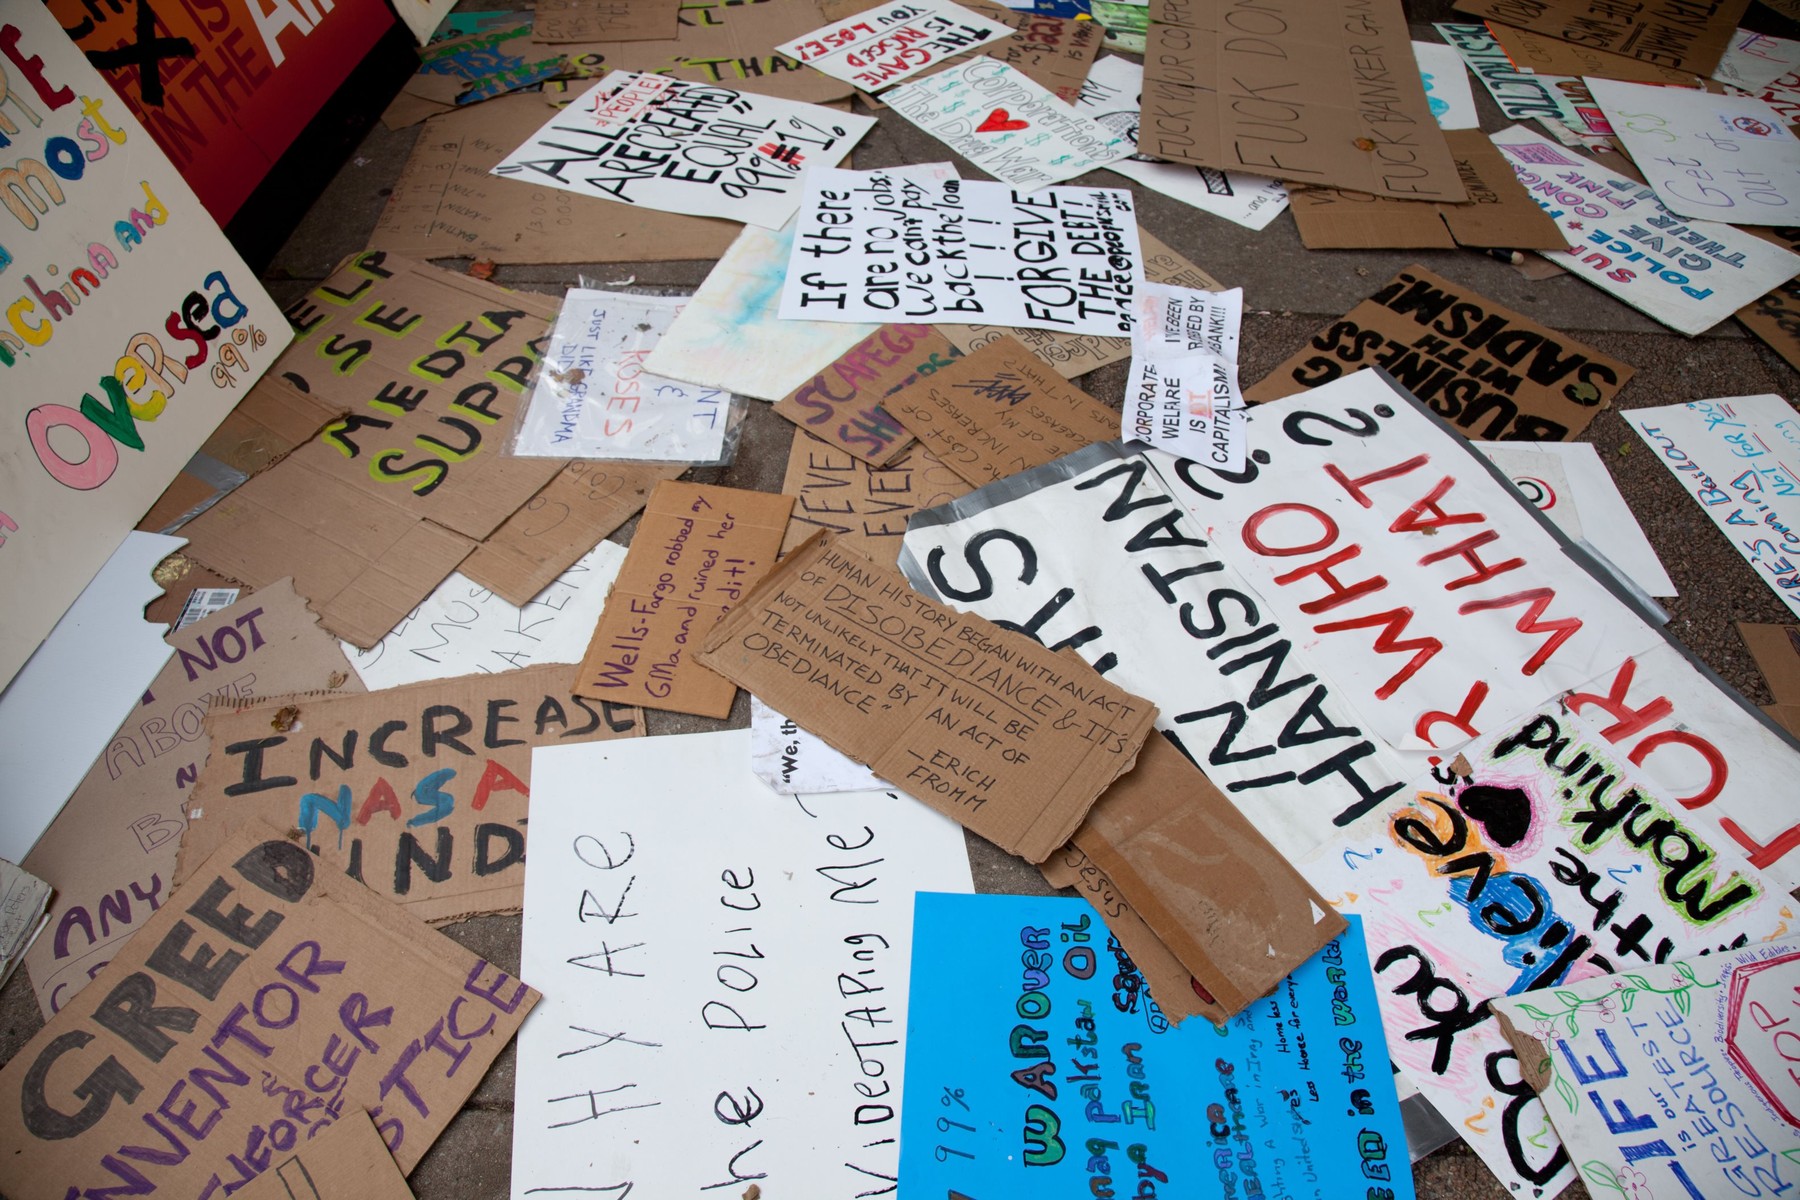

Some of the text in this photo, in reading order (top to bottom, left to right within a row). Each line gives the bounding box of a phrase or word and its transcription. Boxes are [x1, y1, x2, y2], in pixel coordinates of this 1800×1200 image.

[846, 15, 956, 68] IS RIGGED
[877, 3, 926, 28] YOU
[929, 24, 994, 54] THE
[181, 27, 273, 126] THE
[853, 47, 932, 87] GAME
[1347, 44, 1418, 127] BANKER
[896, 82, 940, 125] The
[987, 144, 1054, 187] War
[1154, 54, 1205, 163] FUCK YOUR
[1230, 76, 1326, 177] FUCK
[584, 143, 673, 203] ARE
[901, 177, 932, 212] pay
[929, 178, 964, 212] loan
[1370, 126, 1444, 198] FUCK
[1654, 156, 1736, 208] Get
[800, 188, 854, 311] If there
[931, 211, 967, 246] the
[1061, 199, 1103, 257] DEBT!
[1555, 170, 1748, 270] THEIR PINK
[1618, 223, 1712, 272] GIVE
[862, 226, 902, 312] are no
[1010, 189, 1080, 327] FORGIVE
[1078, 267, 1117, 320] THE
[1585, 228, 1714, 301] POLICE
[586, 308, 607, 340] JUST
[1190, 295, 1206, 314] BY
[1368, 272, 1618, 408] SADISM!
[211, 325, 267, 388] 99%
[322, 308, 527, 458] MEDIA
[557, 343, 578, 373] DID
[1411, 333, 1524, 395] WITH
[928, 387, 1011, 456] INCREASES
[1136, 363, 1160, 443] CORPORATE
[1160, 376, 1181, 439] WELFARE
[1189, 417, 1206, 434] IS
[1211, 362, 1232, 464] CAPITALISM!
[664, 516, 696, 567] robbed
[690, 494, 714, 514] my
[1724, 508, 1759, 527] A
[673, 512, 736, 646] and ruined her
[178, 606, 269, 683] NOT
[773, 590, 1037, 743] NOT UNLIKELY THAT IT WILL BE
[799, 570, 828, 588] OF
[823, 582, 1063, 718] DISOBEDIANCE
[879, 582, 959, 633] HISTORY
[956, 625, 1017, 663] BEGAN
[1015, 655, 1062, 688] WITH
[1058, 680, 1096, 703] AN
[1088, 693, 1137, 720] ACT
[763, 608, 1032, 766] TERMINATED BY AN ACT OF
[223, 694, 638, 799] INCREASE
[297, 757, 532, 850] NASA
[906, 764, 988, 813] FROMM
[53, 872, 164, 962] ANY
[20, 837, 318, 1142] GREED
[1712, 990, 1729, 1044] Biodiversity
[1735, 950, 1757, 966] Wild
[1759, 943, 1789, 961] Edibles
[1338, 1036, 1367, 1085] the
[1662, 996, 1797, 1199] RESOURCE
[935, 1086, 977, 1162] 99%
[1626, 1015, 1763, 1200] GREATEST
[1657, 1086, 1698, 1152] is our
